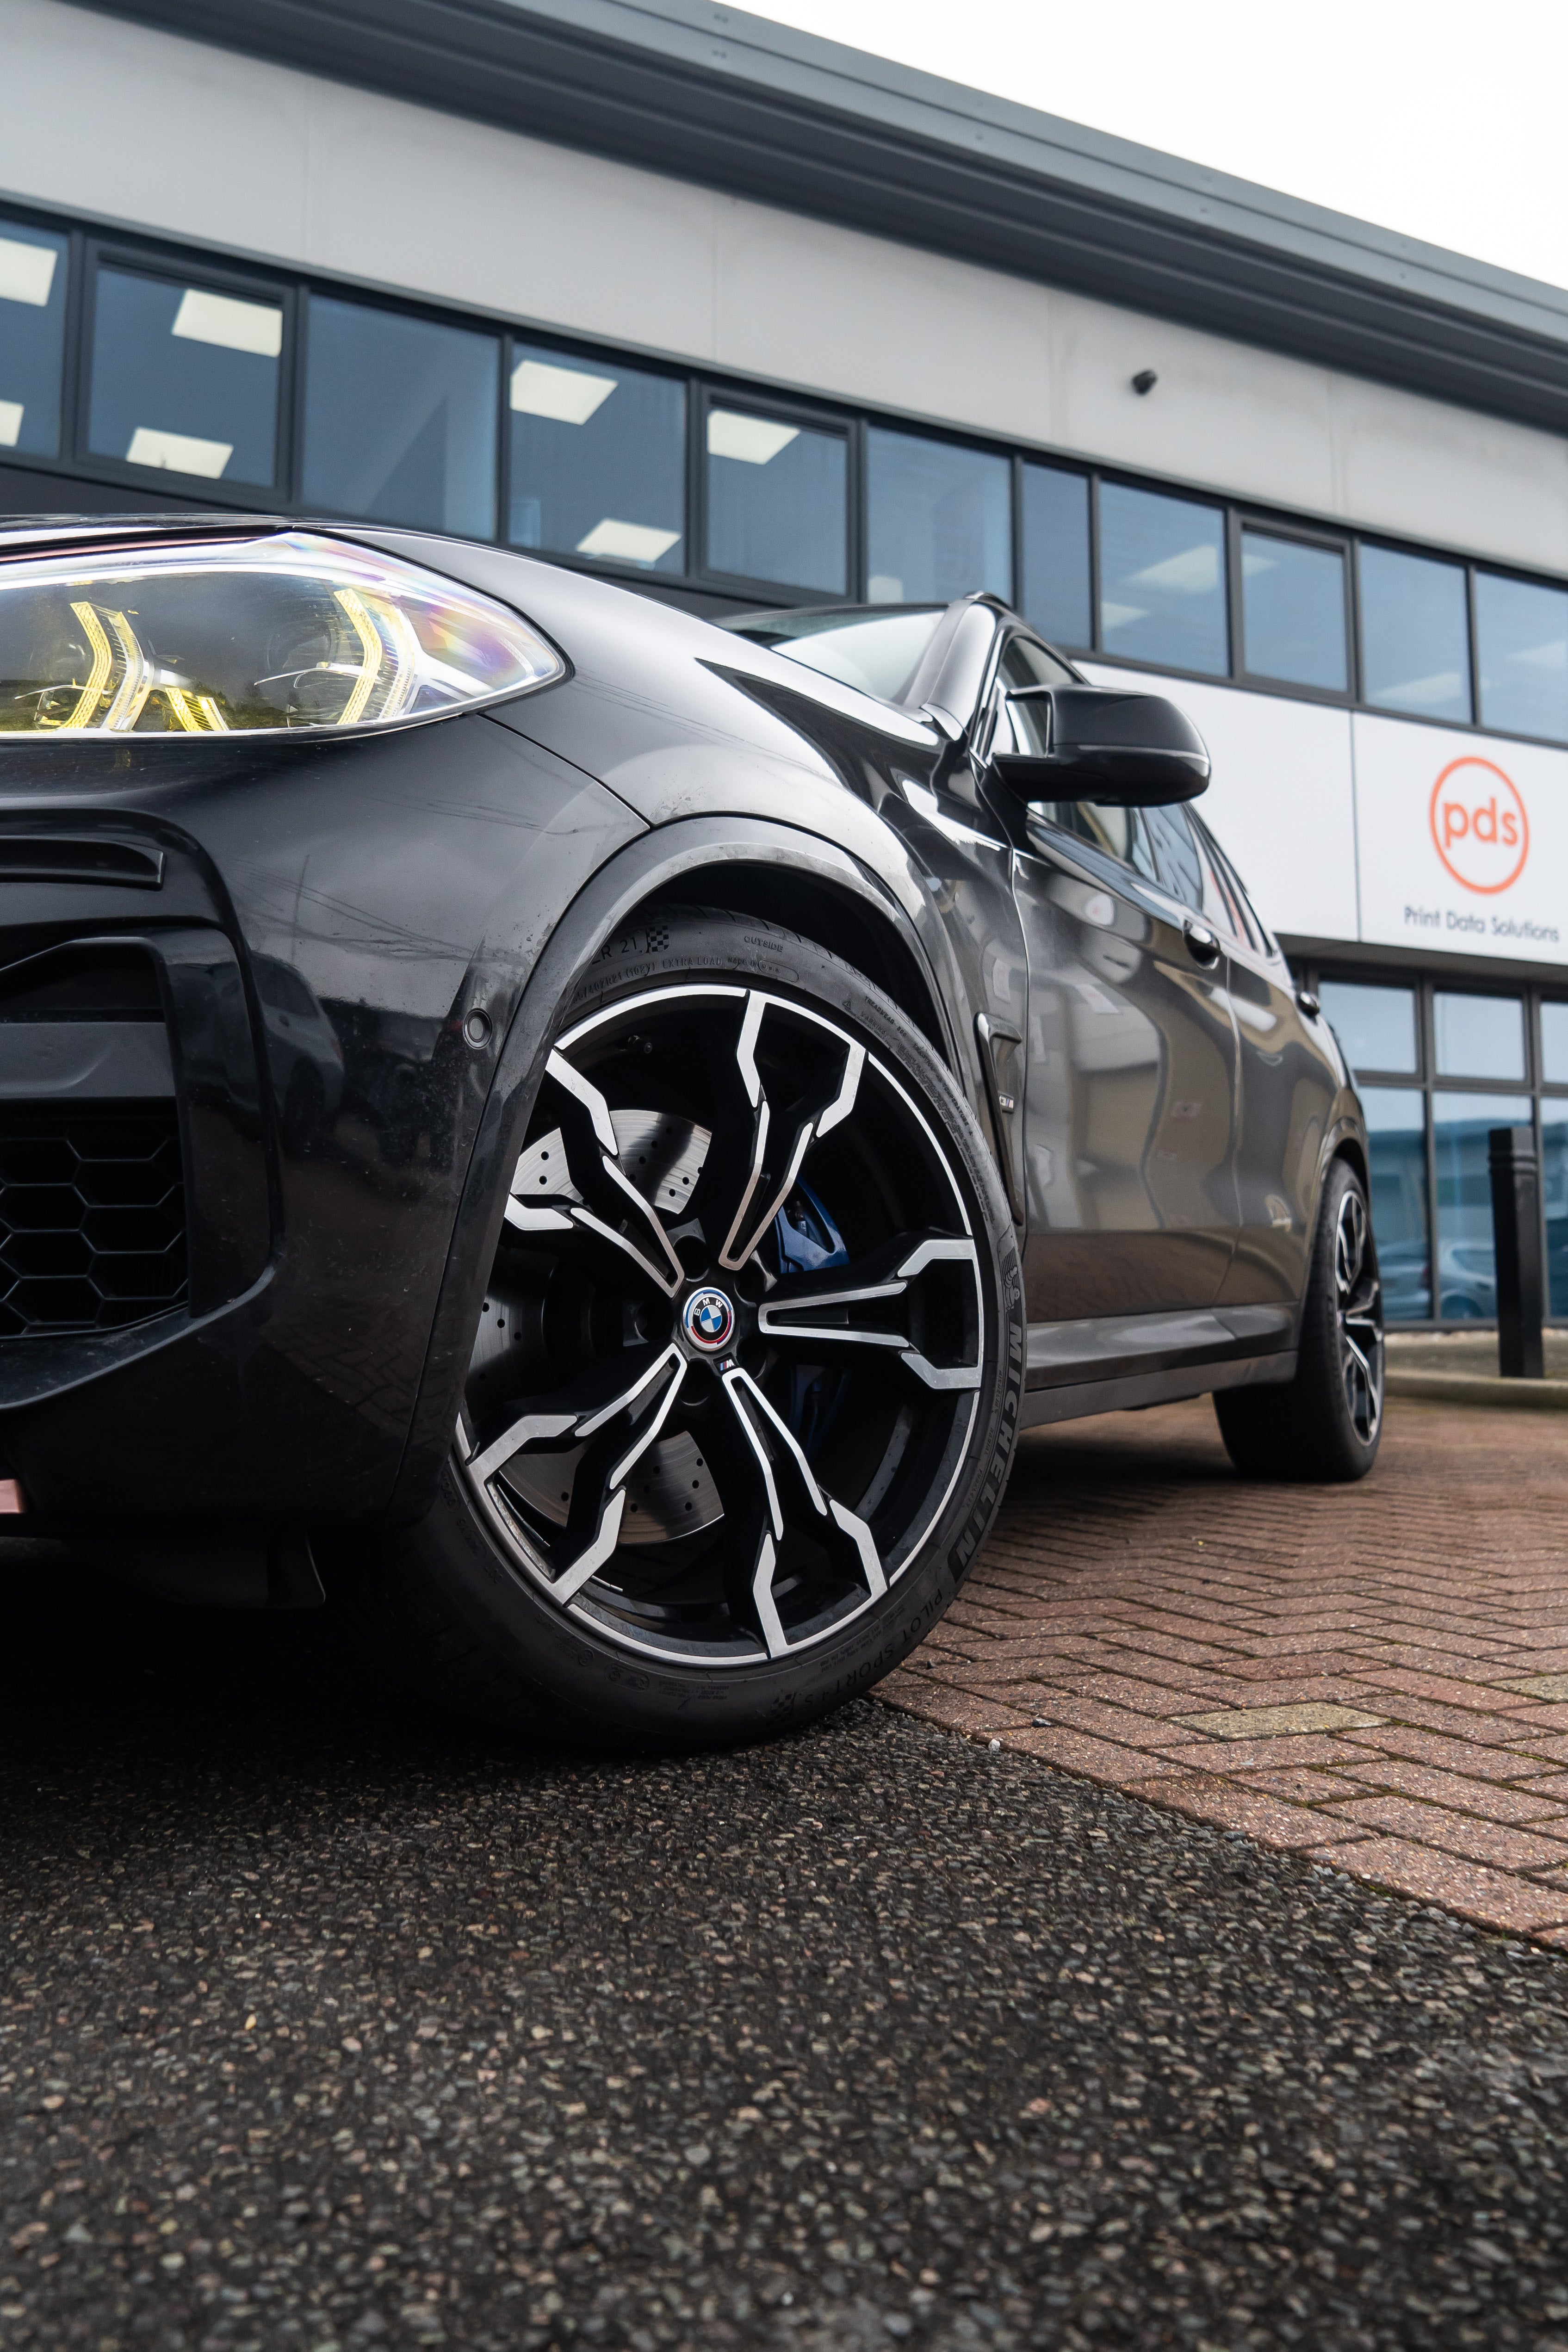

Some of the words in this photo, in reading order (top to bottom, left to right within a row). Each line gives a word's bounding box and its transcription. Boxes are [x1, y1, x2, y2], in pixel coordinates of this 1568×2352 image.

[1443, 796, 1518, 848] pds
[1404, 905, 1440, 928] Print
[1446, 910, 1486, 934] Data
[1492, 915, 1560, 943] Solutions
[620, 936, 637, 953] 21
[663, 958, 694, 969] EXTRA
[697, 957, 722, 966] LOAD
[744, 935, 784, 953] OUTSIDE
[694, 1298, 723, 1316] BMW
[956, 1322, 1022, 1566] MICHELIN
[901, 1587, 943, 1647] PILOT
[834, 1645, 894, 1694] SPORT
